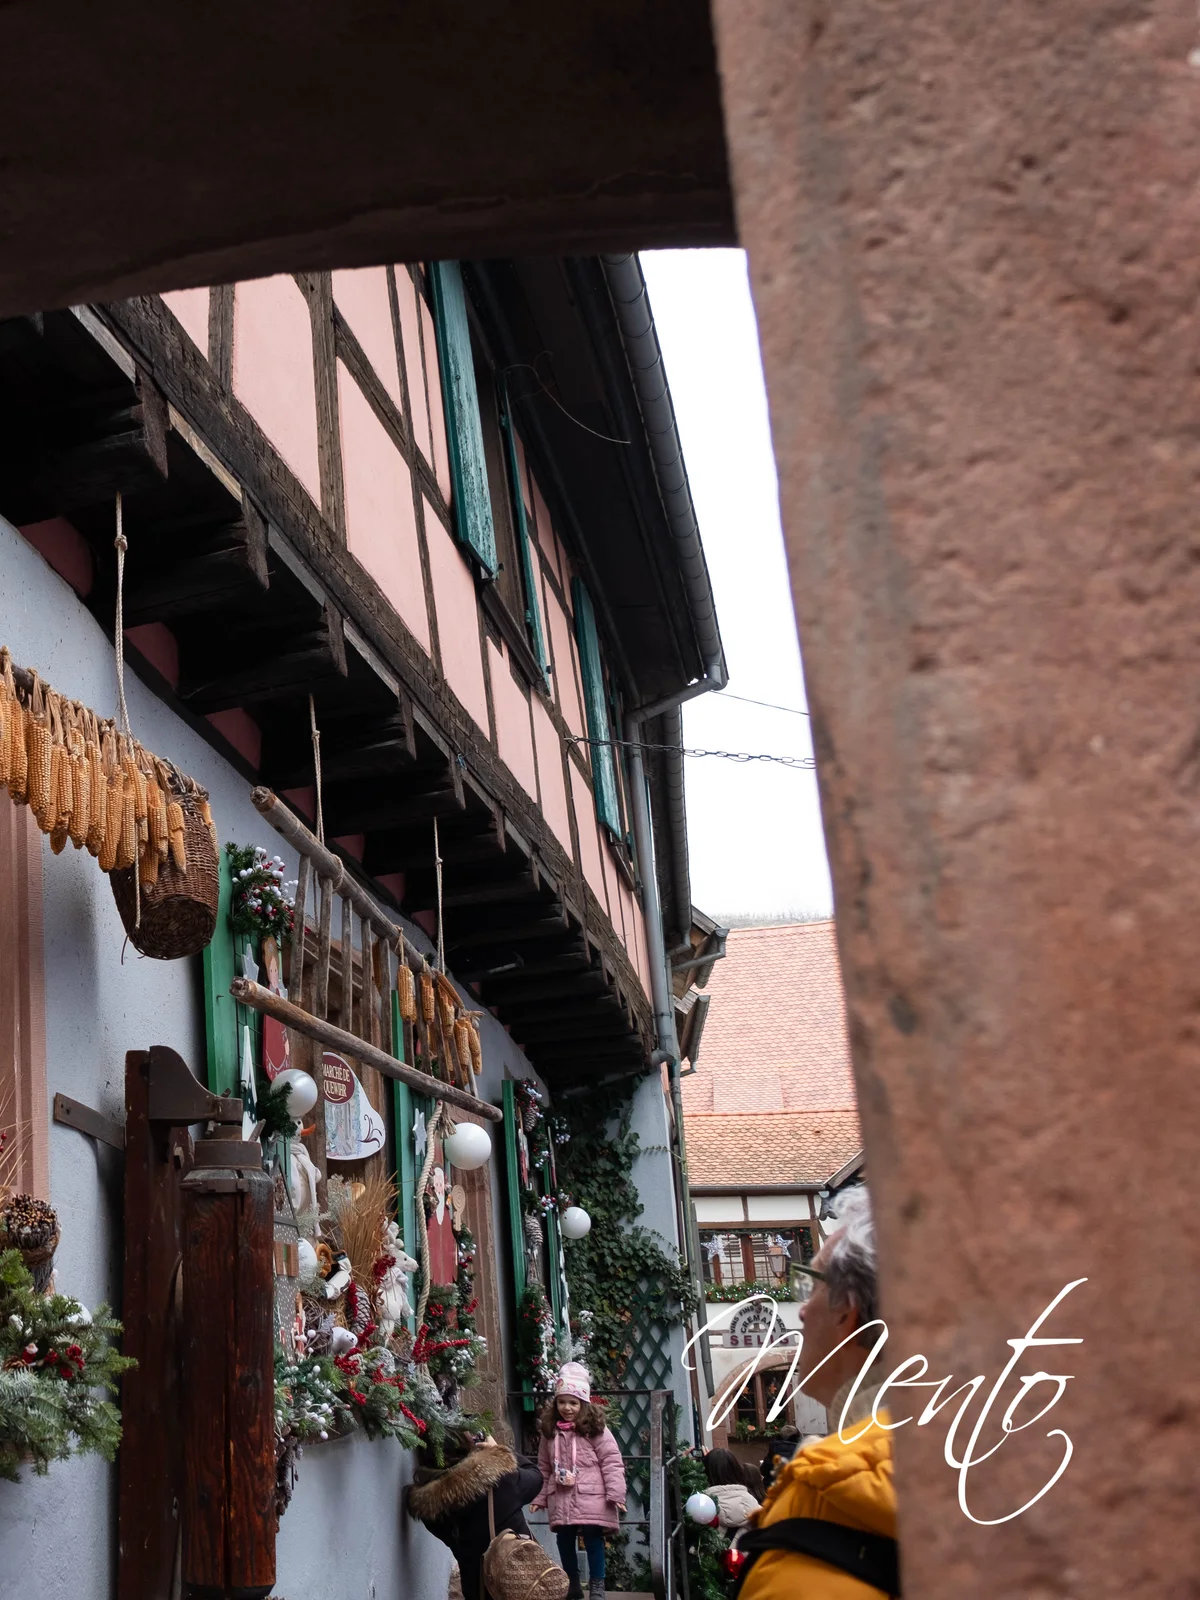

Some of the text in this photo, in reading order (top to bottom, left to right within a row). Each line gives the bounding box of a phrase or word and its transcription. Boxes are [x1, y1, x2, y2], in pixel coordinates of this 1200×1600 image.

[342, 1068, 350, 1082] DE
[323, 1079, 347, 1101] QUEWIHR
[730, 1316, 740, 1334] VINS
[739, 1305, 755, 1316] FINS
